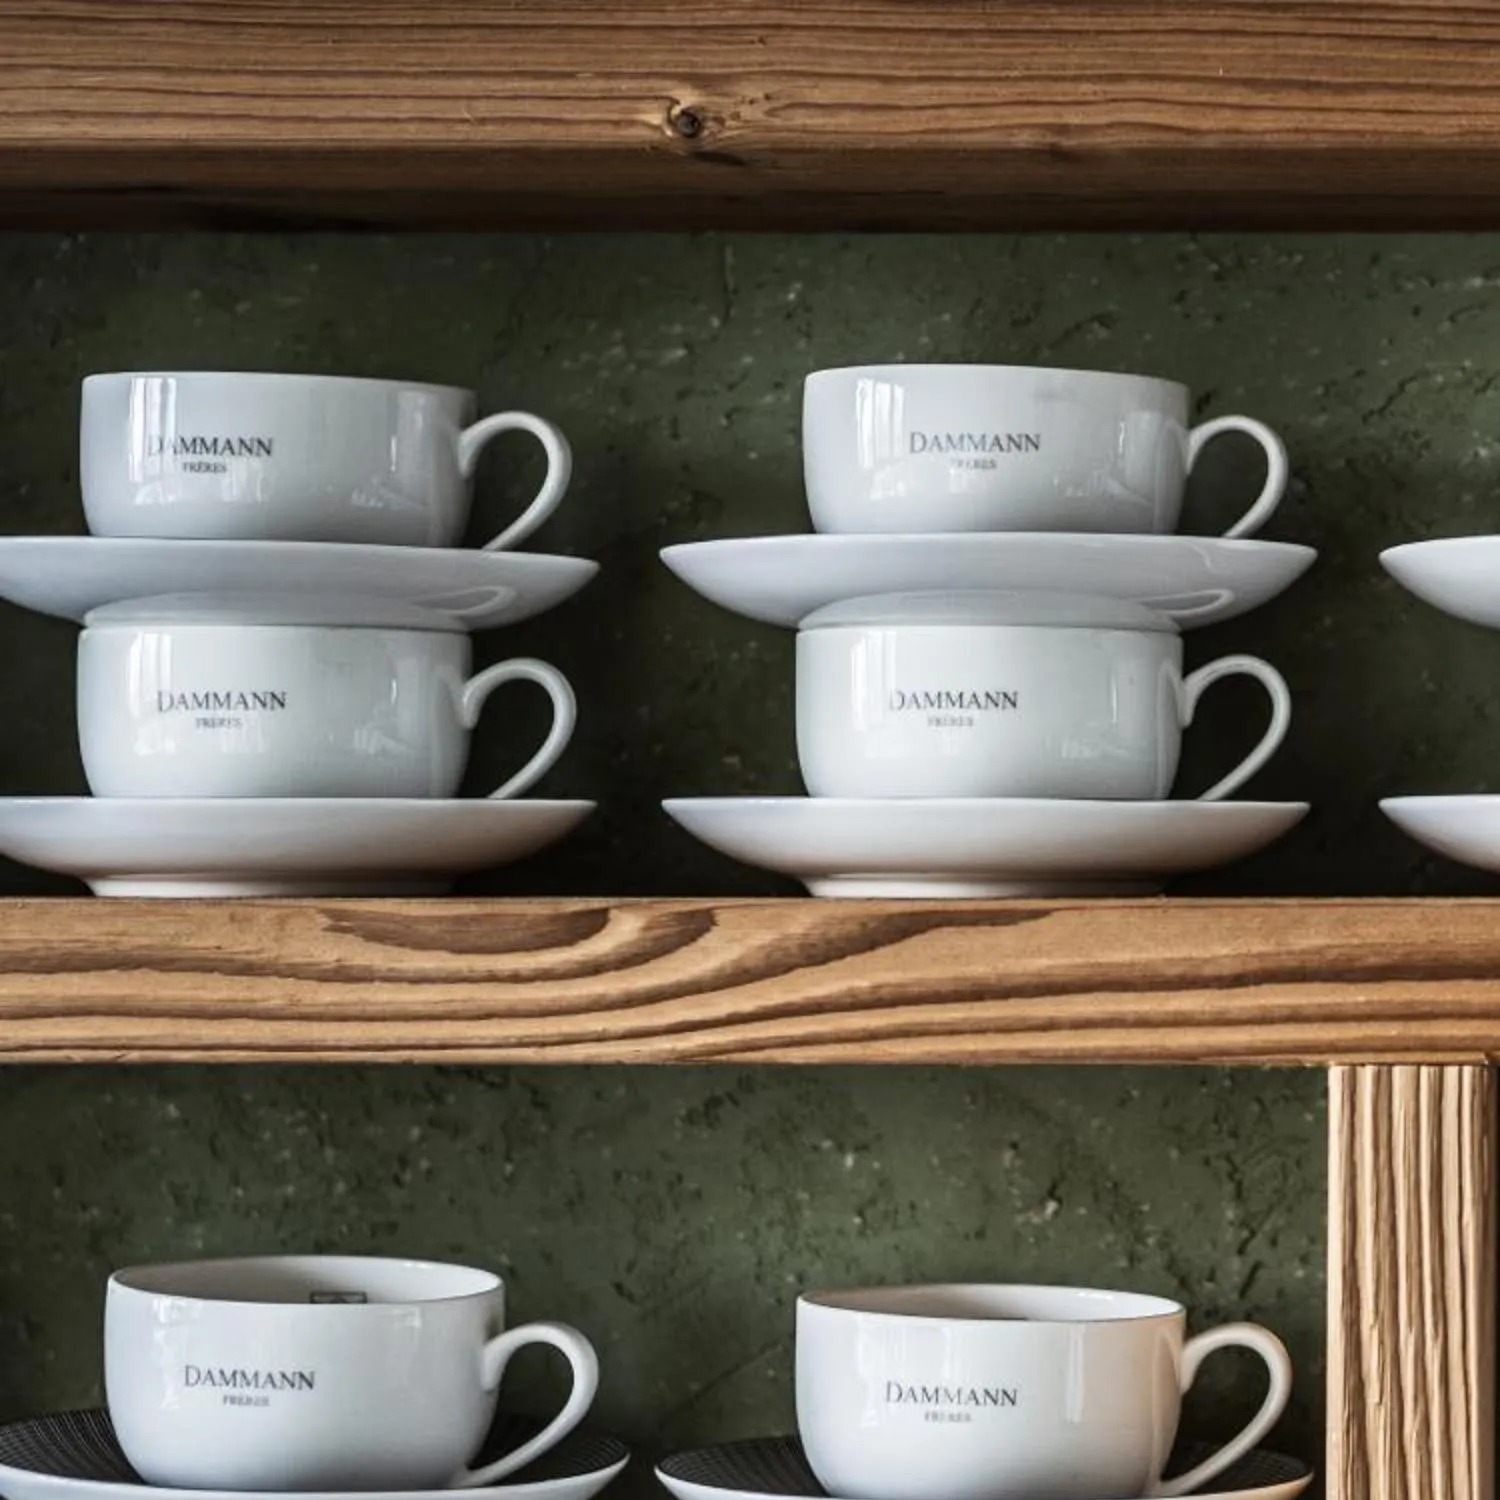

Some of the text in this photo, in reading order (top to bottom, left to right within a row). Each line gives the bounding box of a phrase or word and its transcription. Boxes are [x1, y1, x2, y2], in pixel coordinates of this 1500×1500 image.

[910, 431, 1040, 455] DAMMANN
[158, 691, 287, 713] DAMMANN
[890, 690, 1017, 711] DAMMANN
[184, 1364, 316, 1391] DAMMANN
[886, 1380, 1017, 1407] DAMMANN
